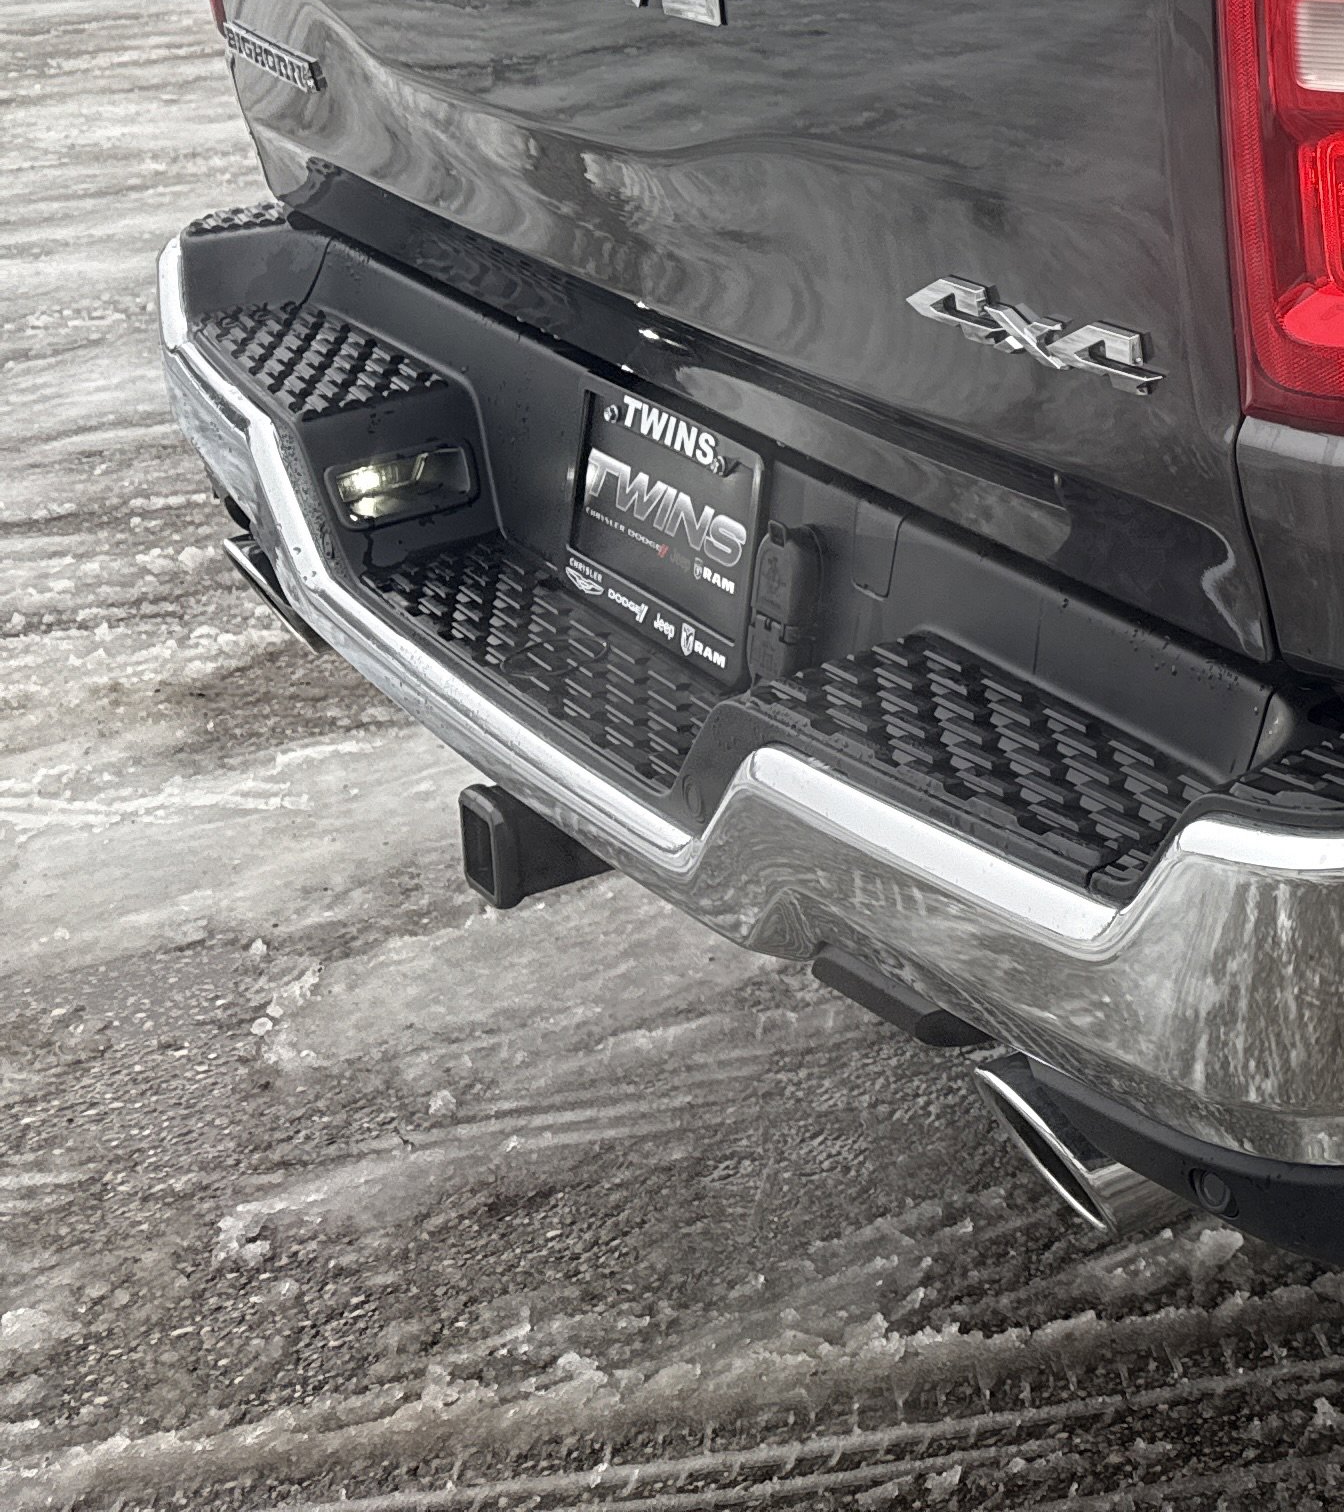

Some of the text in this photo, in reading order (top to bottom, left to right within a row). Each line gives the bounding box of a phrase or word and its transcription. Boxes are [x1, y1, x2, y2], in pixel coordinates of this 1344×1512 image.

[623, 395, 717, 466] TWINS
[586, 446, 748, 568] TWINS
[702, 566, 735, 595] RAM
[653, 612, 676, 640] Jeep
[694, 640, 726, 669] RAM
